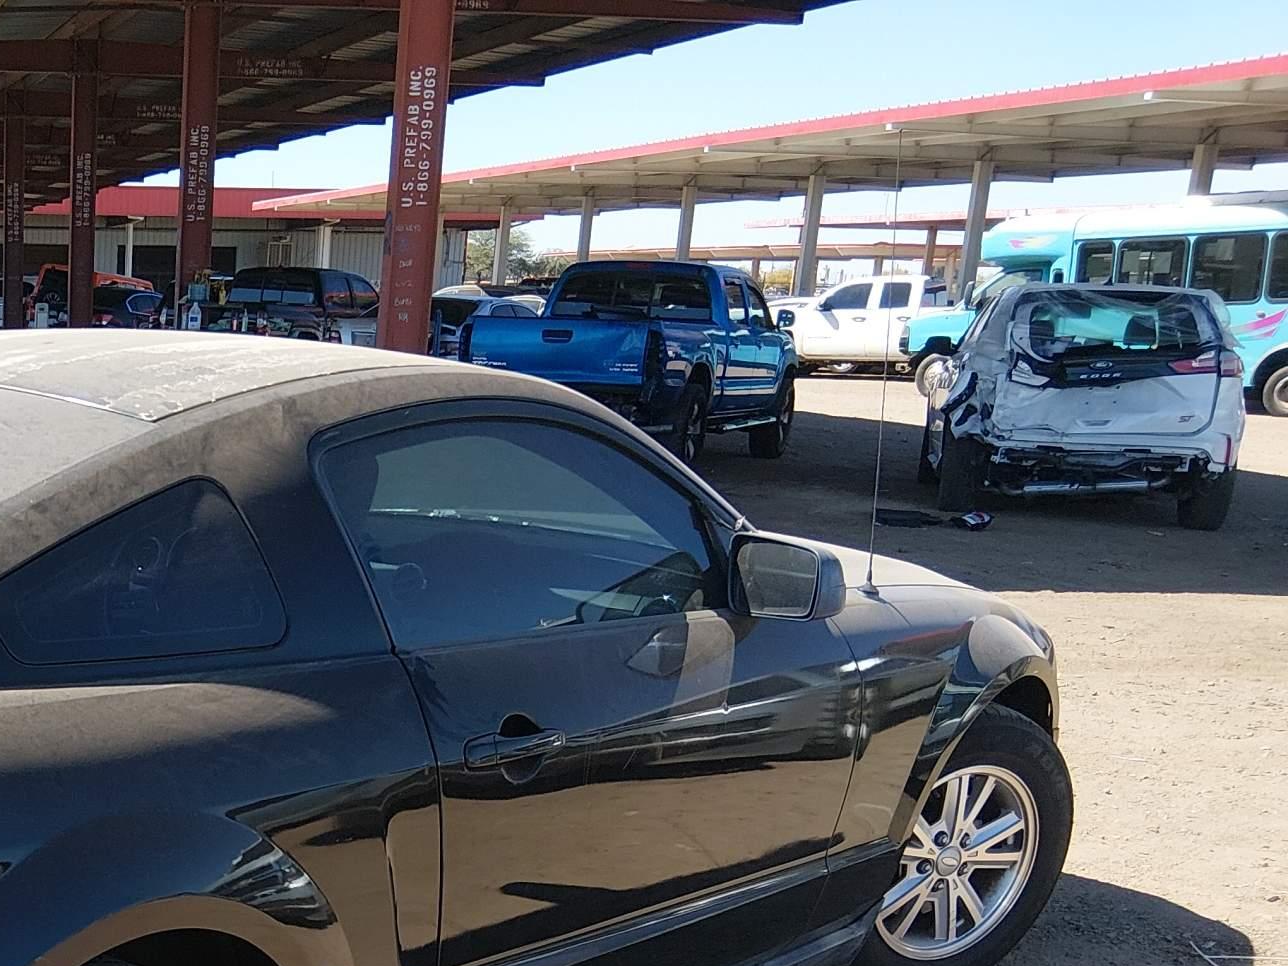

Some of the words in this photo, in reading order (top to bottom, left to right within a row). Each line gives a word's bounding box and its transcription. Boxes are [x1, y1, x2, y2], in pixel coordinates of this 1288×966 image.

[408, 65, 423, 96] INC.
[190, 124, 200, 146] INC.
[403, 104, 420, 168] PREFAB
[416, 67, 437, 206] 1-866-799-0969
[188, 151, 198, 194] PREFAB
[196, 125, 209, 221] 1-866-799-0969
[185, 200, 196, 222] U.S.
[401, 177, 415, 208] U.S.
